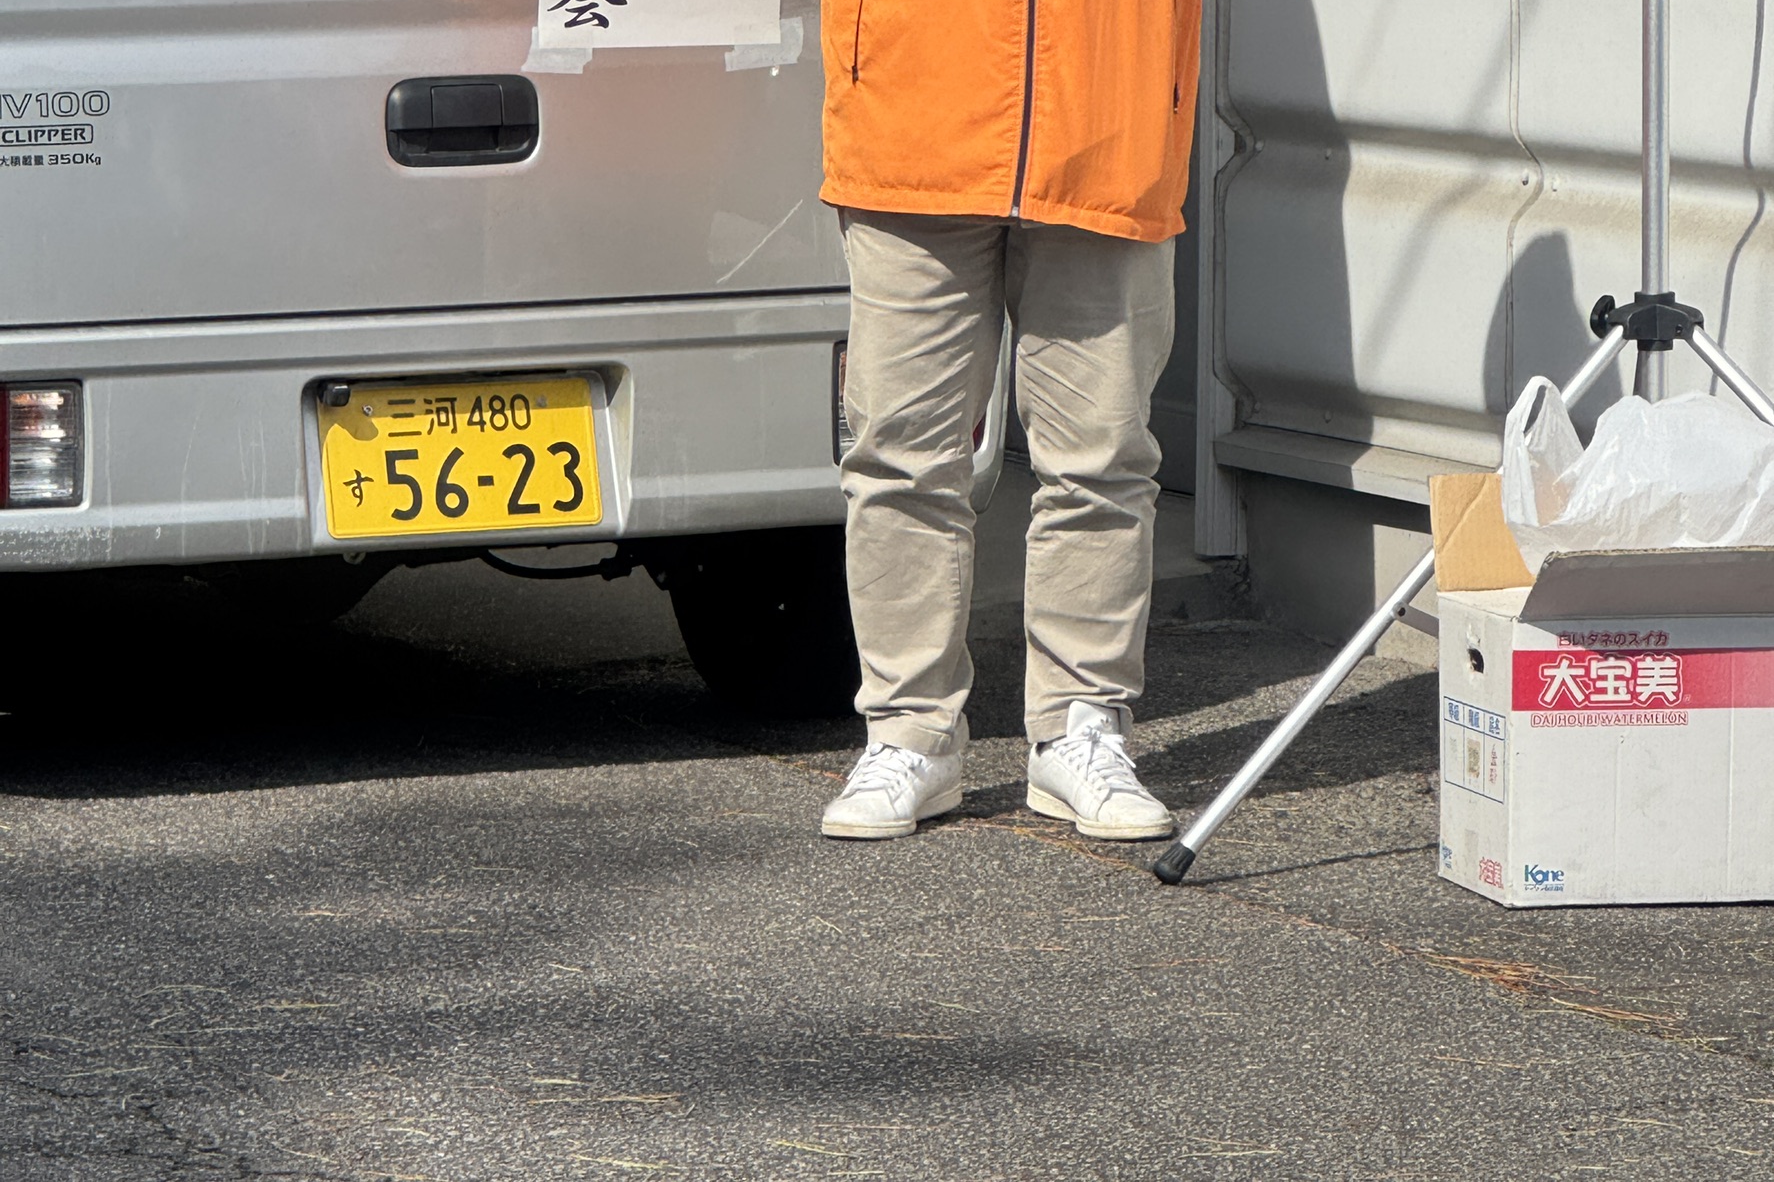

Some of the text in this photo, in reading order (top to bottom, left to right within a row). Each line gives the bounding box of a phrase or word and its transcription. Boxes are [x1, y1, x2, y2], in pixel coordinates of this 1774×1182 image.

[0, 91, 110, 119] V100
[2, 128, 86, 143] CLIPPER
[387, 393, 532, 436] 三河 480
[343, 442, 584, 520] す 56-23
[1558, 632, 1668, 647] 白いタネのスイカ
[1541, 654, 1680, 705] 大宝美
[1600, 712, 1688, 726] WATERMELON
